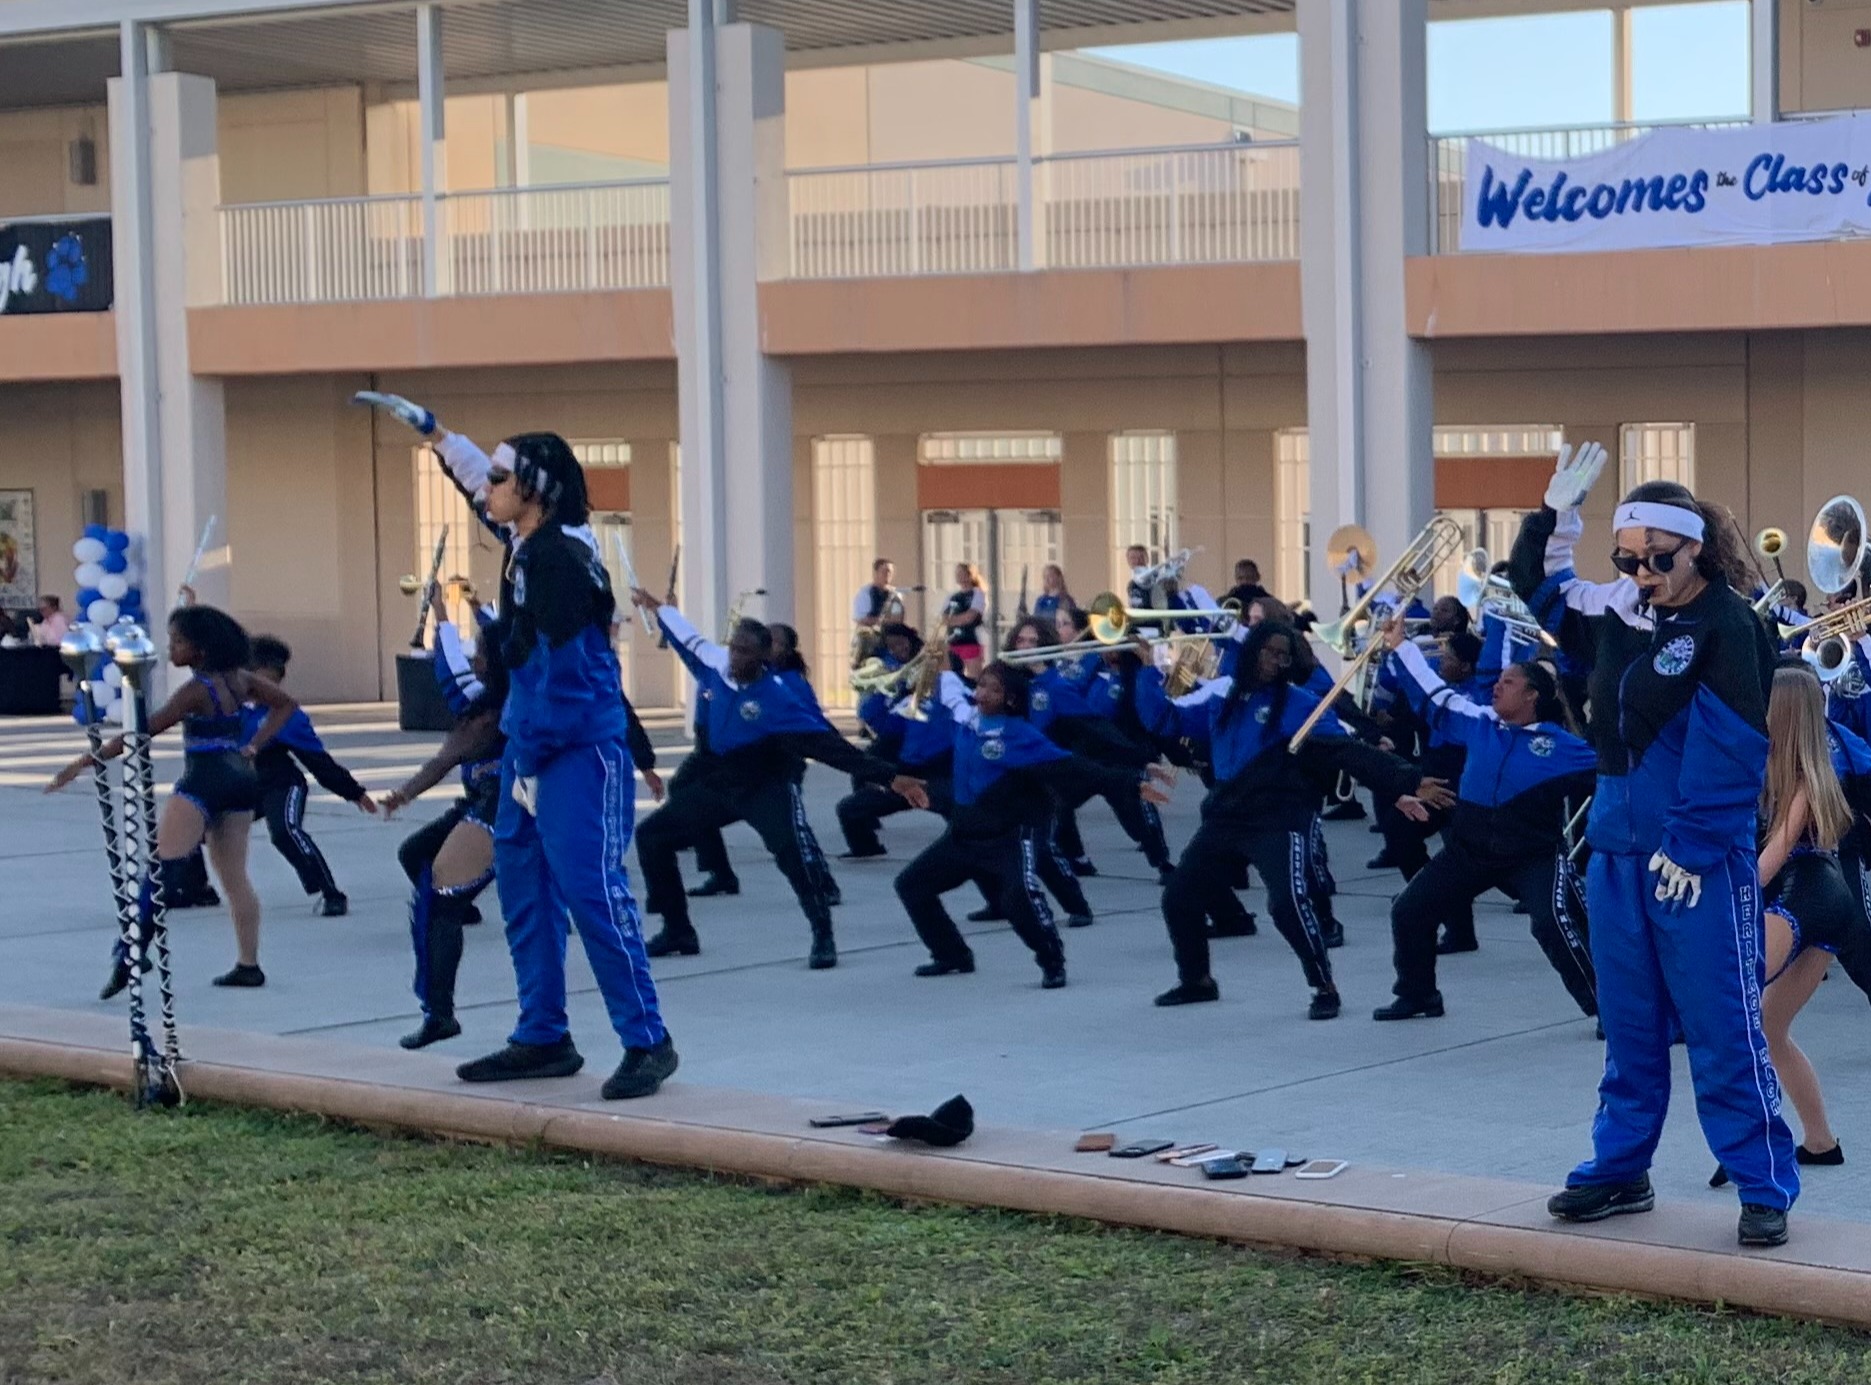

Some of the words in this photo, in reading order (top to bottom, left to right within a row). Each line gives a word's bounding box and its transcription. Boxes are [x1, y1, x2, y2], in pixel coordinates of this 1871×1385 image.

[1477, 164, 1709, 229] Welcomes
[1743, 152, 1849, 201] Class
[1851, 164, 1869, 187] of
[1739, 885, 1761, 1029] HERITAGE
[1759, 1047, 1781, 1117] HIGH
